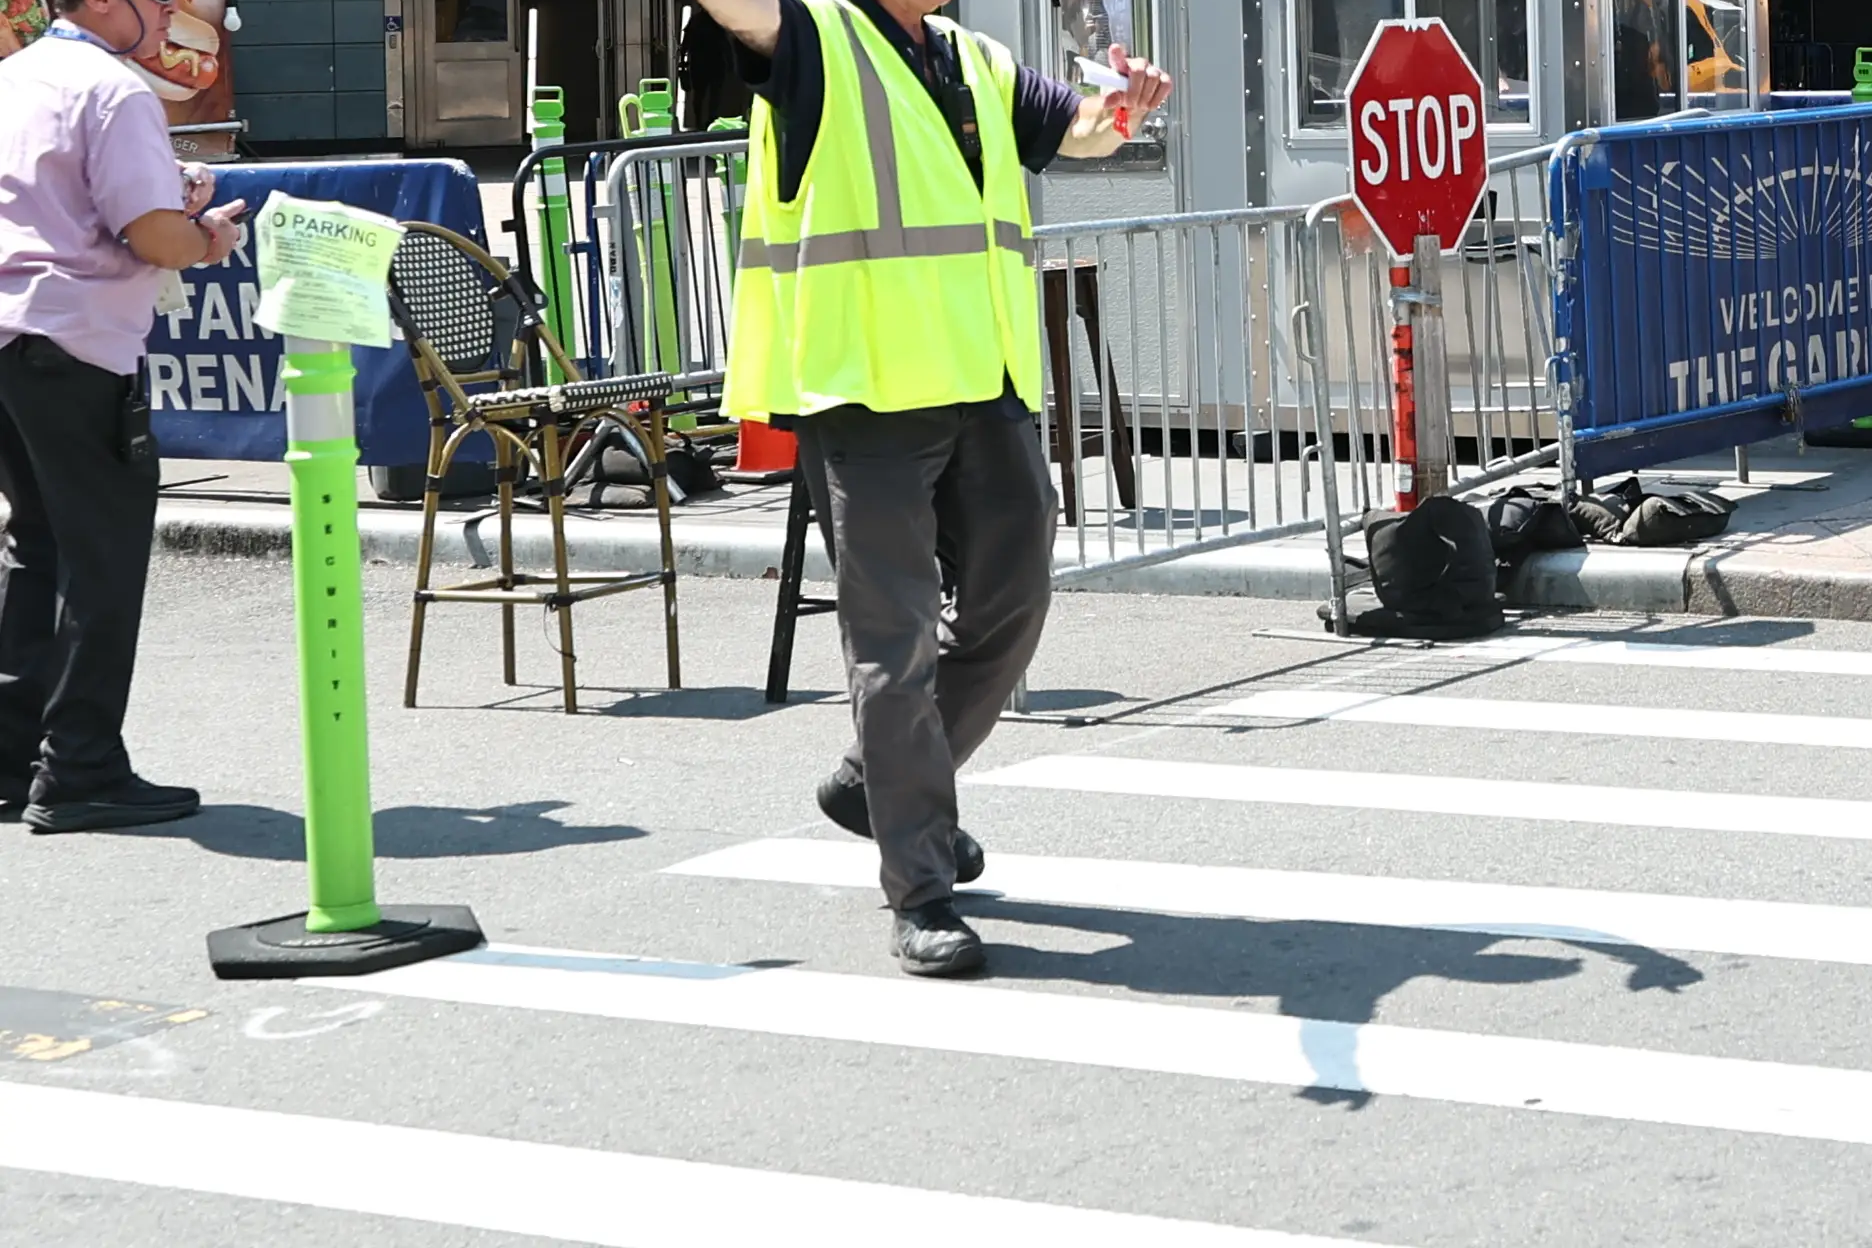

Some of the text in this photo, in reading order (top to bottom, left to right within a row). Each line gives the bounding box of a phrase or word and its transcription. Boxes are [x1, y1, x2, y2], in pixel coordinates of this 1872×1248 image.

[169, 137, 198, 153] GER
[1360, 93, 1477, 186] STOP
[292, 214, 377, 248] PARKING
[1719, 276, 1858, 336] WELCOME
[1668, 346, 1758, 413] THE
